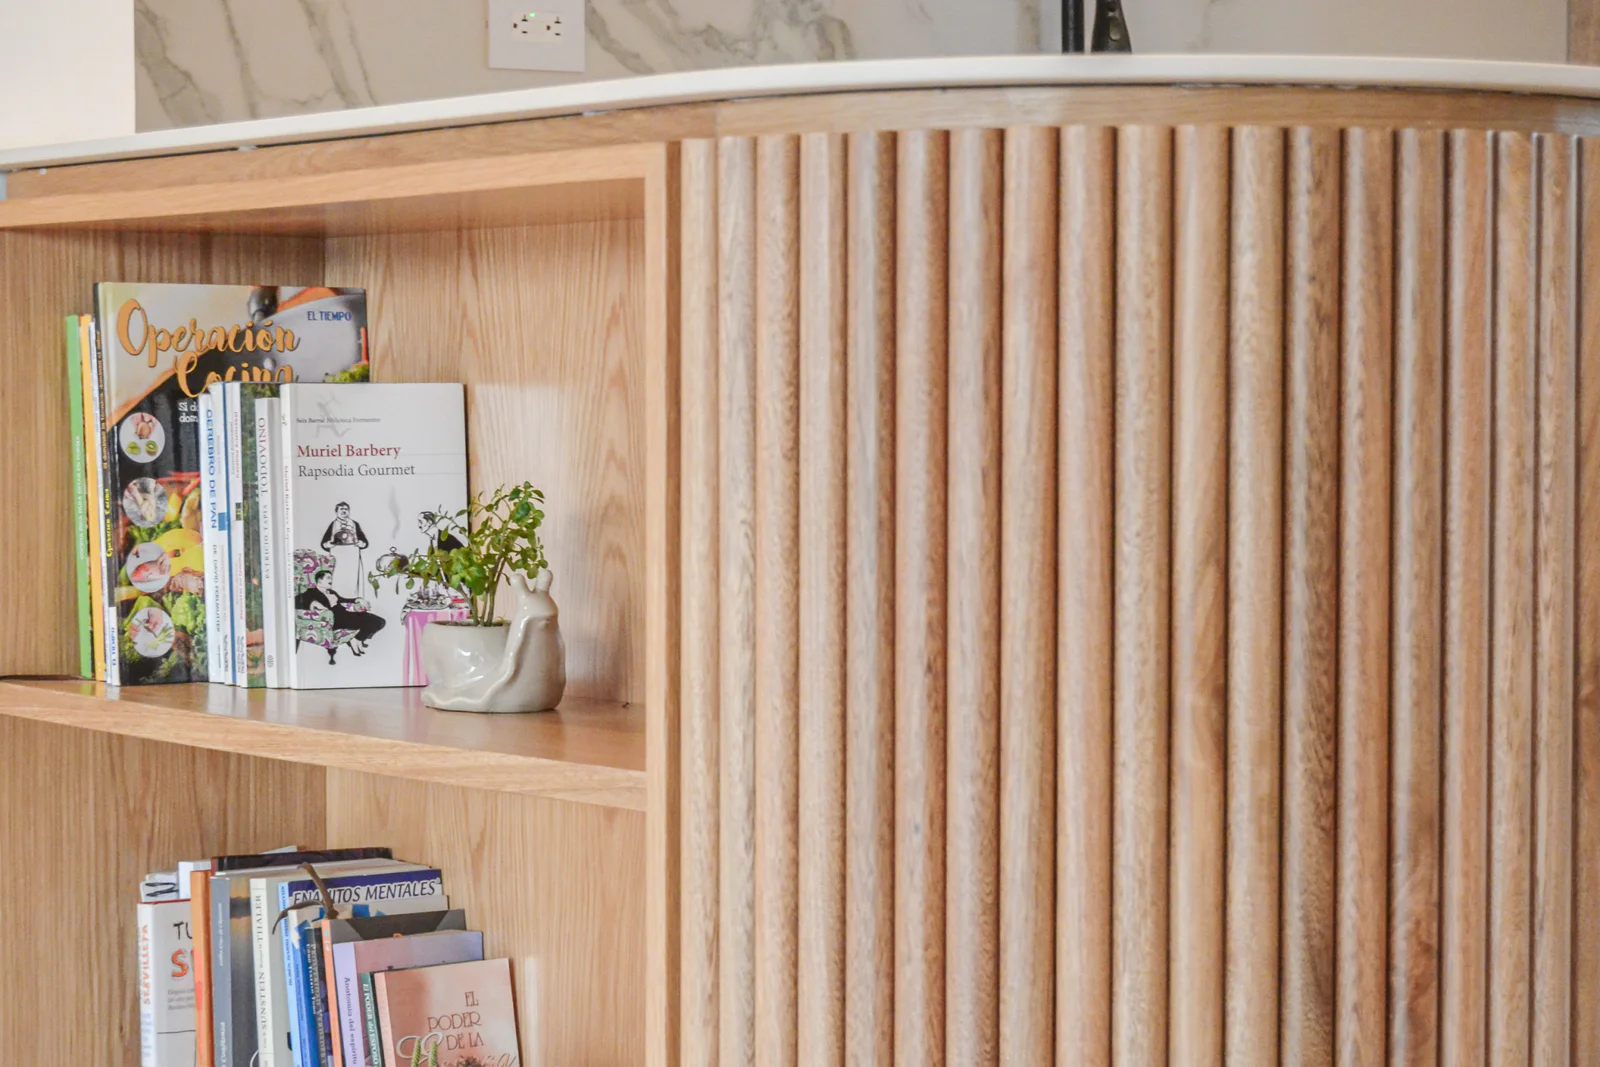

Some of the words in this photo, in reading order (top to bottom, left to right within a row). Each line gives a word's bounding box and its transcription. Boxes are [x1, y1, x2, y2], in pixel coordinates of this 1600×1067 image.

[307, 310, 317, 321] EL
[319, 310, 353, 321] TIEMPO
[117, 298, 301, 367] Operación
[206, 409, 216, 476] CEREBRO
[297, 443, 342, 458] Muriel
[345, 443, 402, 460] Barbery
[258, 417, 269, 497] TODOVINO
[298, 463, 354, 480] Rapsodia
[357, 464, 416, 477] Gourmet
[208, 479, 217, 498] DE
[210, 502, 218, 529] PAN
[293, 886, 361, 905] ENAITOS
[365, 880, 436, 901] MENTALES
[255, 895, 264, 943] THALER
[259, 971, 268, 1030] SUNSTEIN
[464, 991, 479, 1007] EL
[364, 993, 373, 1020] PODER
[370, 1033, 379, 1065] ESPOSO
[427, 1011, 482, 1032] PODER
[446, 1033, 465, 1051] DE
[469, 1032, 485, 1048] LA
